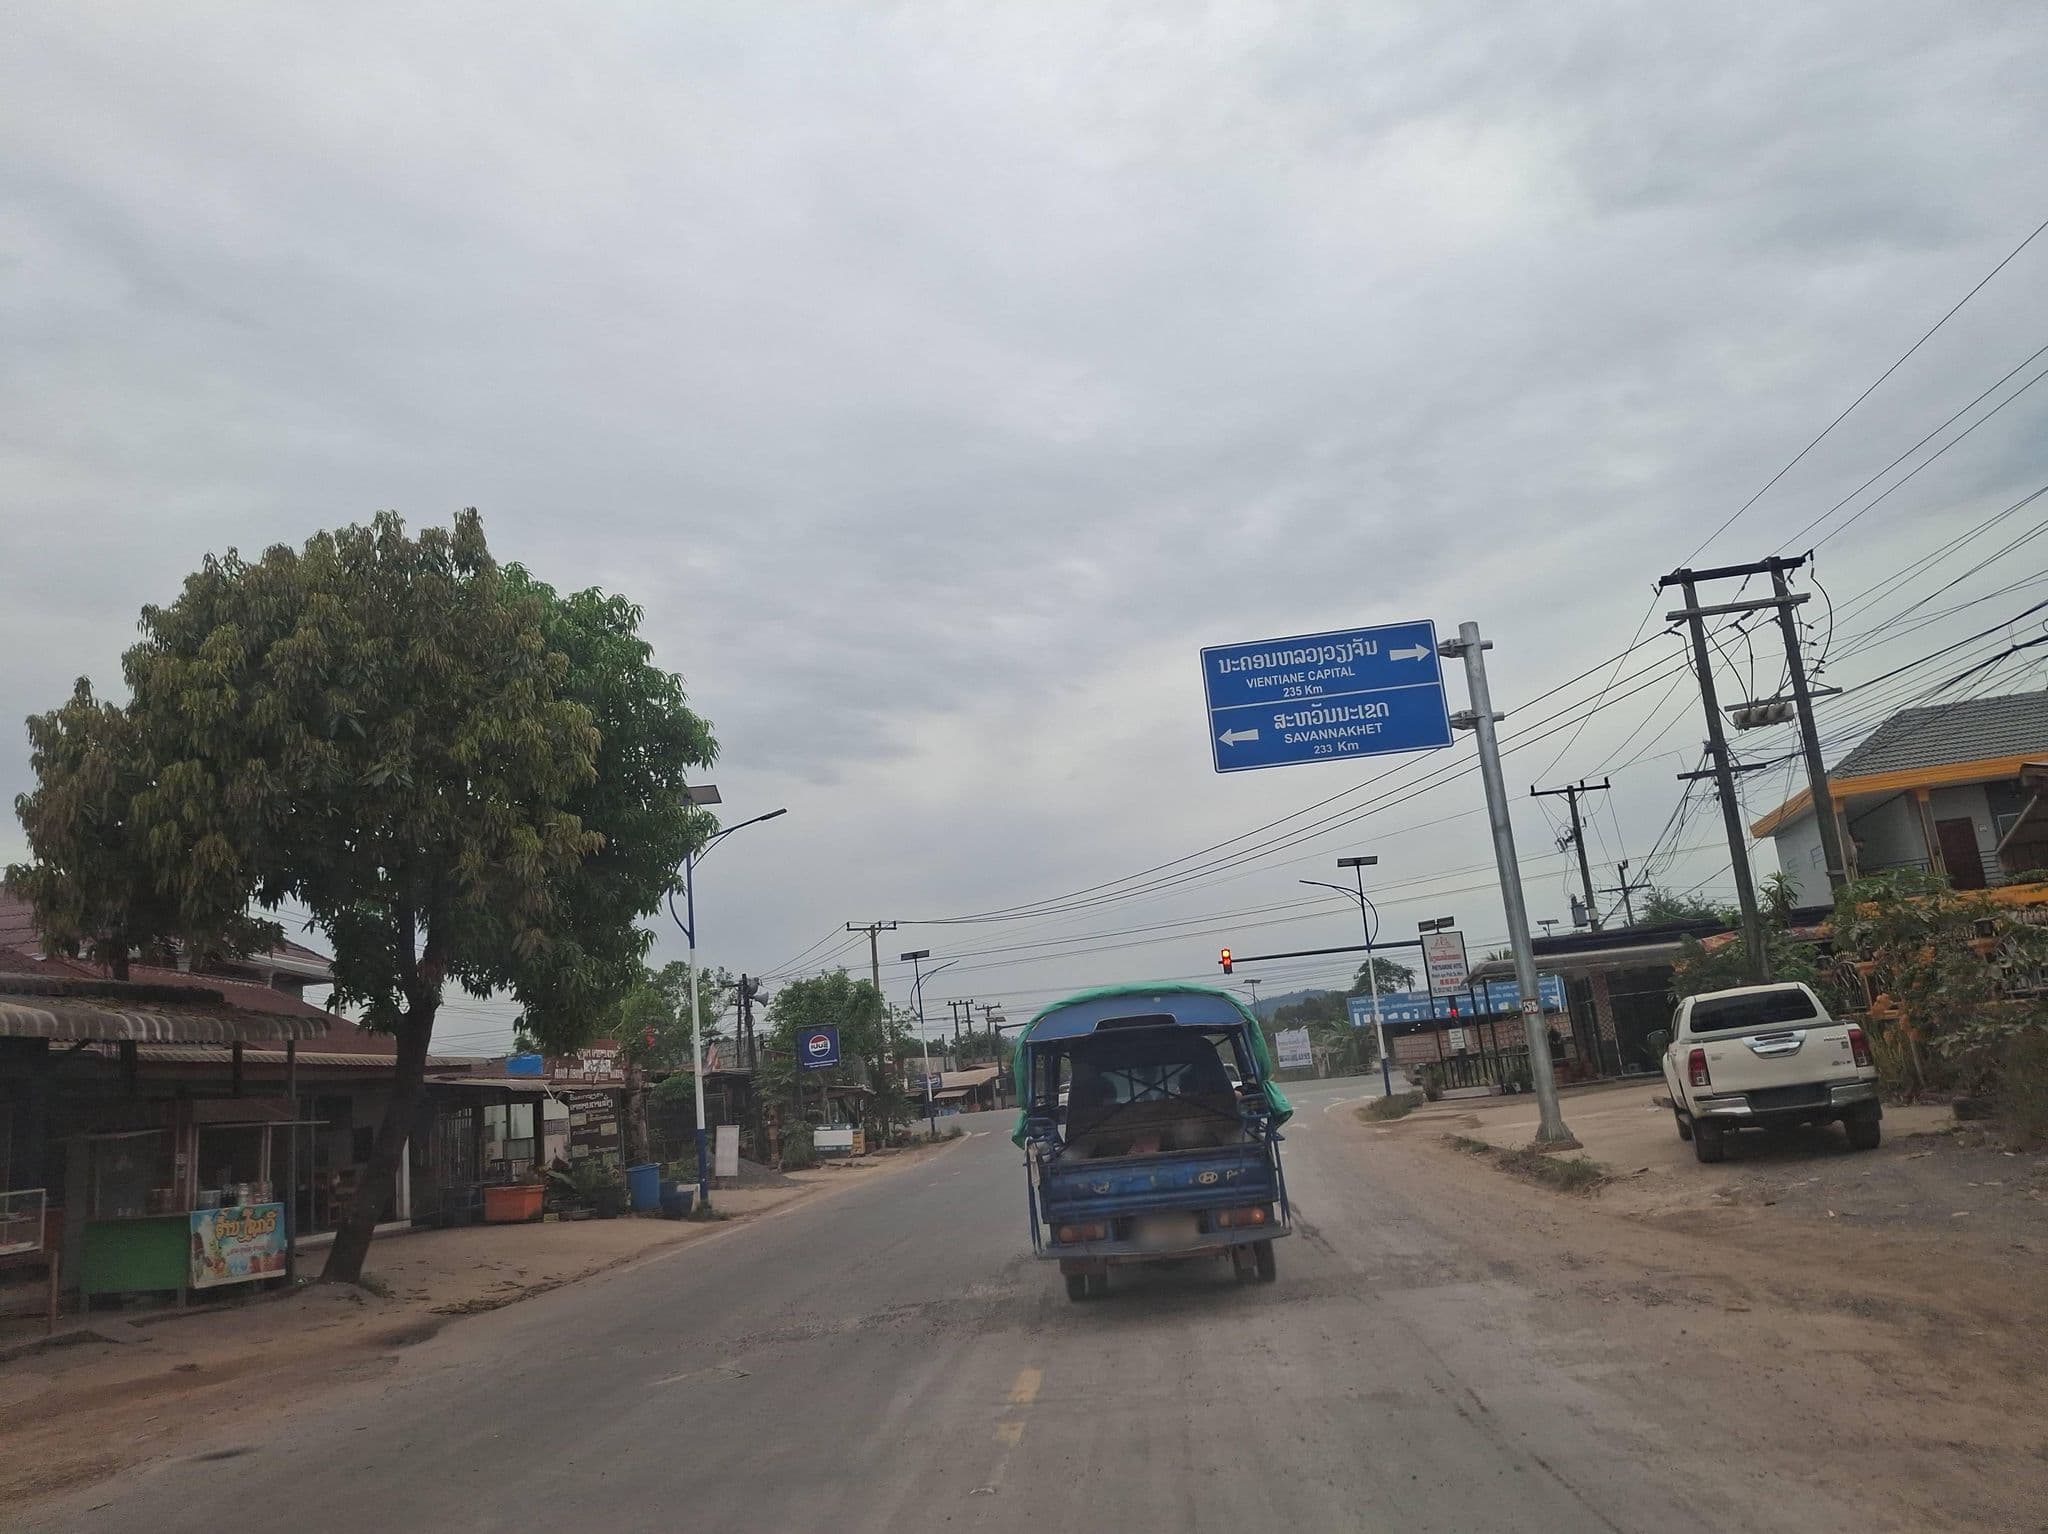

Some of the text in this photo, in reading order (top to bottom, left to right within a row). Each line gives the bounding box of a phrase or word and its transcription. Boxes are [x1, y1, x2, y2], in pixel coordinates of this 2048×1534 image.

[1246, 666, 1356, 689] VIENTIANE CAPITAL
[1283, 685, 1323, 699] 235 Km
[1273, 702, 1390, 730] ສະຫວັນນະເຂດ
[1284, 722, 1383, 744] SAVANNAKHET
[1313, 741, 1360, 755] 233 Km
